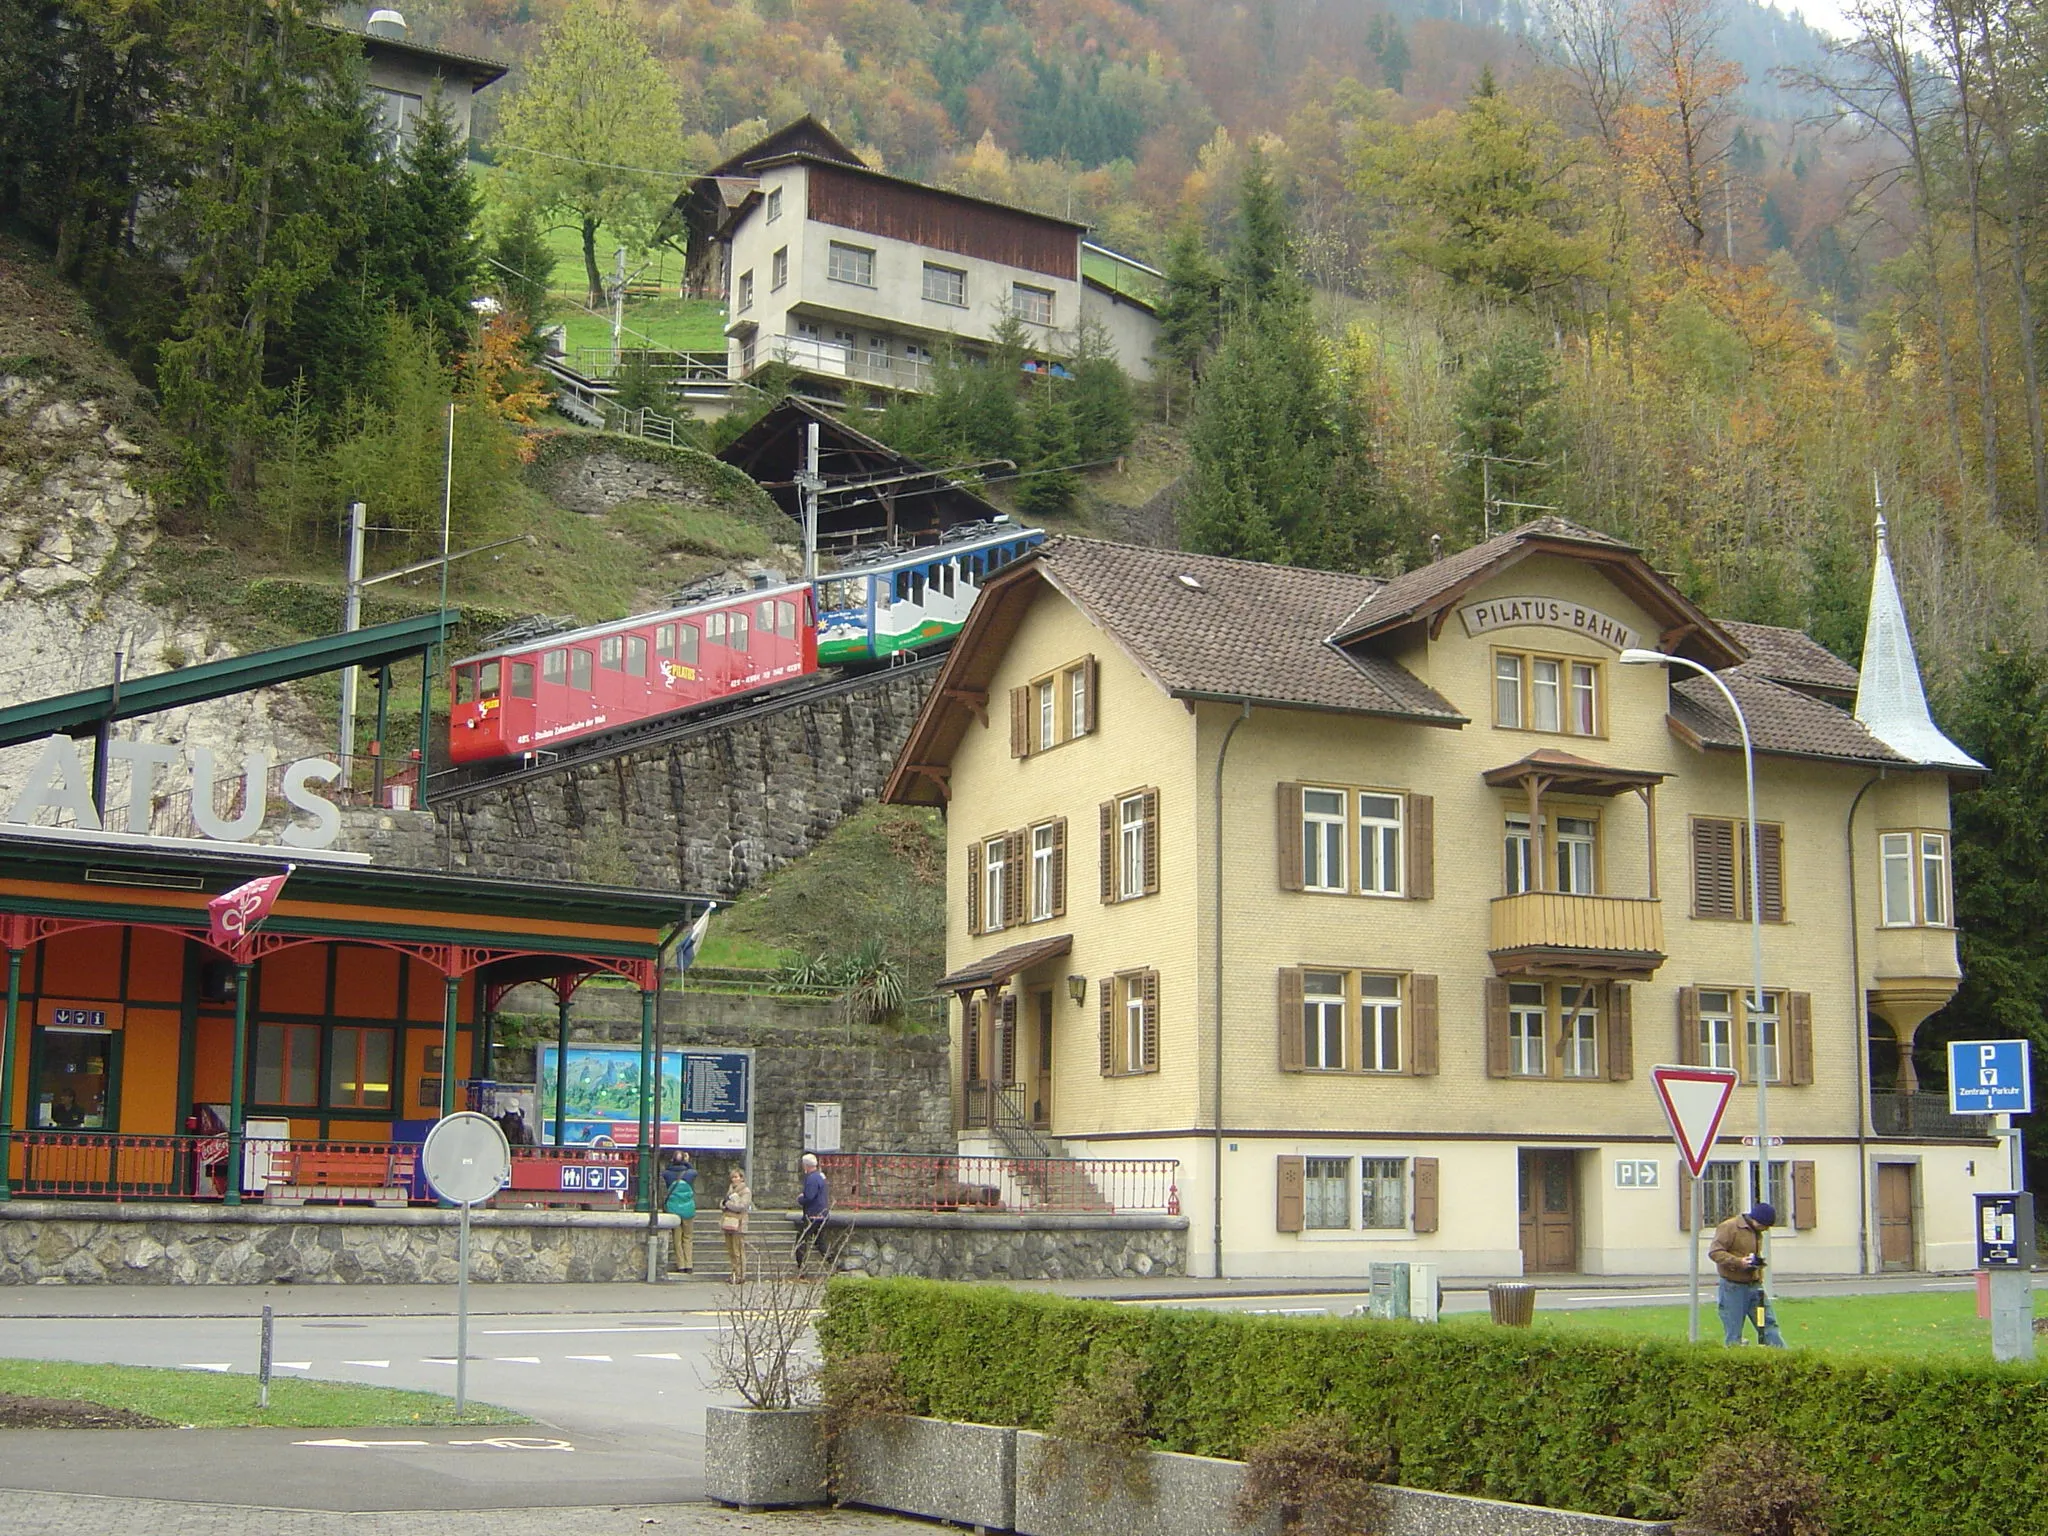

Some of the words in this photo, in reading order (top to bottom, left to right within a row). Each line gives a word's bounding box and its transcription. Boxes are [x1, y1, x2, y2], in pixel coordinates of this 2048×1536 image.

[1476, 602, 1628, 646] PILATUS-BAHN
[671, 663, 696, 681] PILATUS
[8, 734, 342, 849] ATUS
[1980, 1045, 1996, 1068] P
[1991, 1086, 2020, 1095] Parkuhr
[1621, 1164, 1632, 1183] P
